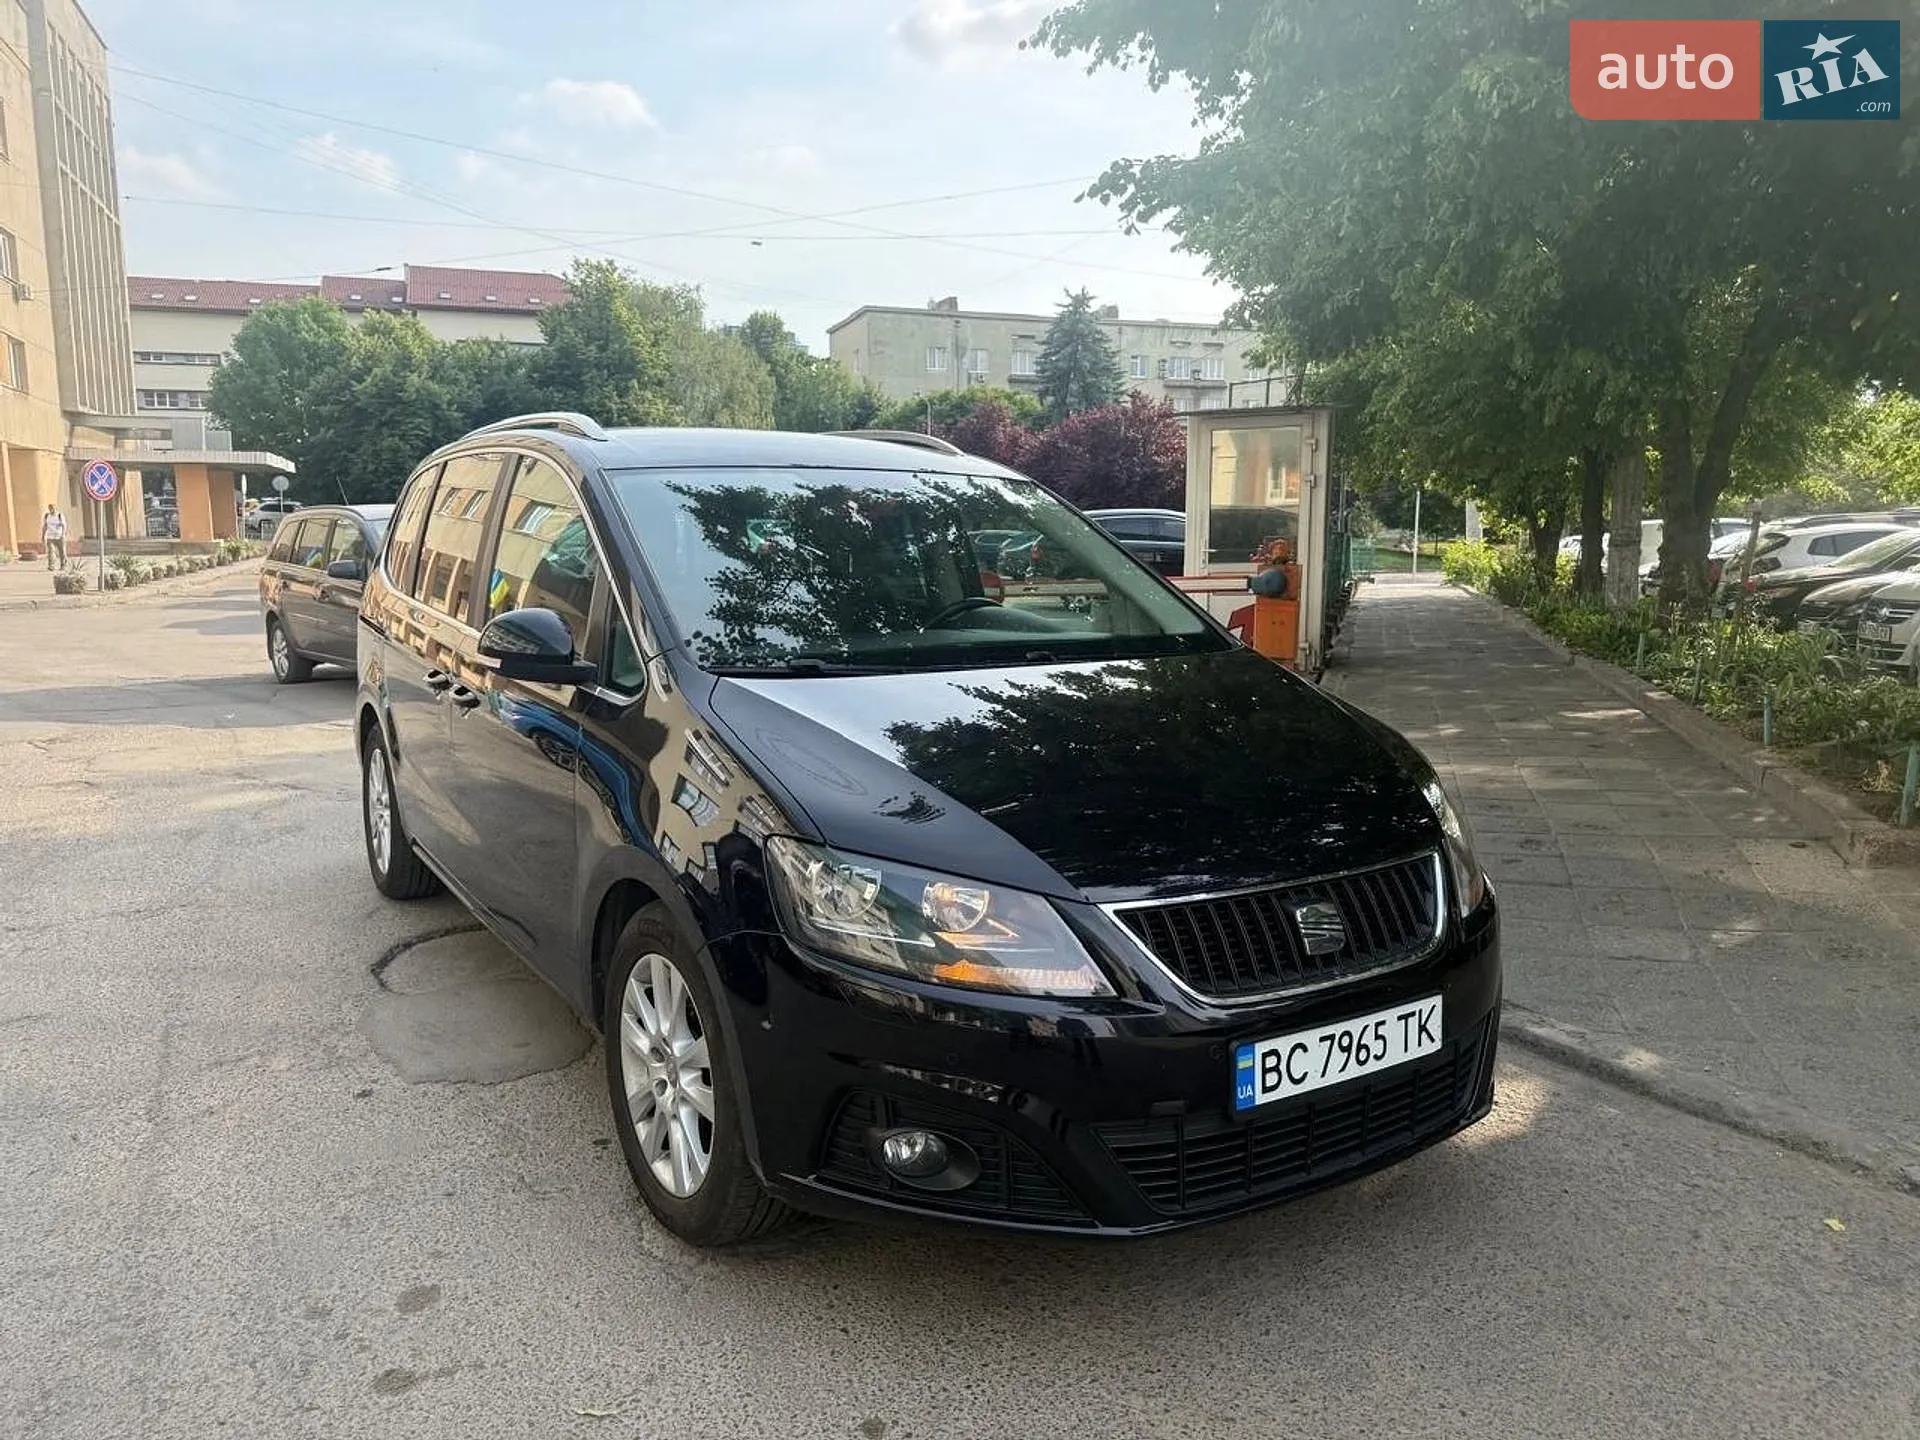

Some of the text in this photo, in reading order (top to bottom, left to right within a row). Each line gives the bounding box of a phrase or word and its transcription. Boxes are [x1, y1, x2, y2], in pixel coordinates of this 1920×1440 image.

[1261, 1004, 1437, 1095] BC 7965 TK
[1237, 1084, 1254, 1099] UA
